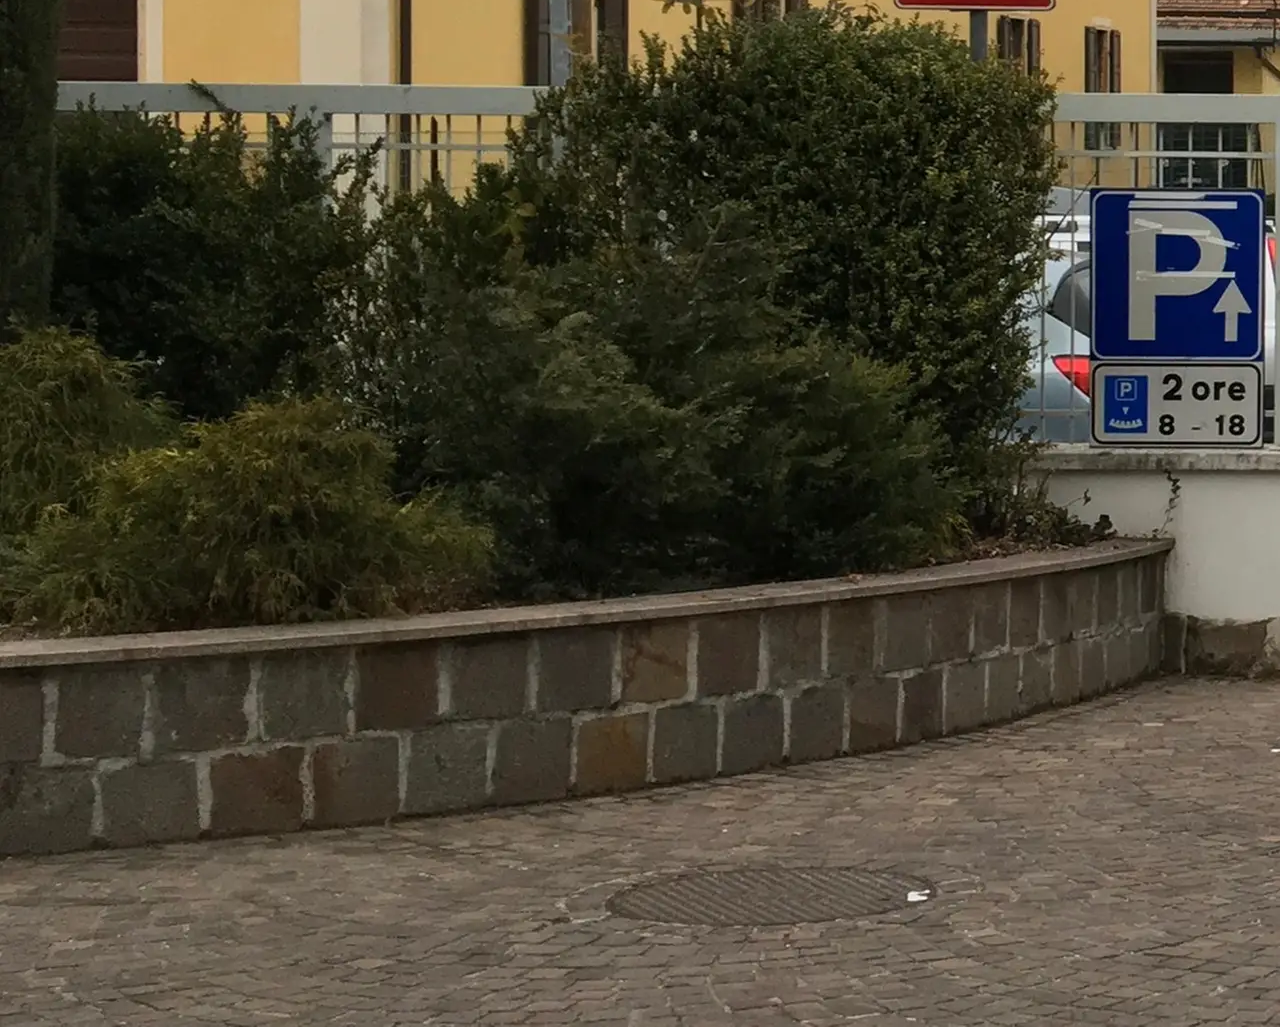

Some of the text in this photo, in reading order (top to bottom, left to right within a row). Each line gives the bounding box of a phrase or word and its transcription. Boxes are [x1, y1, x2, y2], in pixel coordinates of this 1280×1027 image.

[1162, 374, 1182, 401] 2
[1191, 379, 1246, 401] ore
[1159, 414, 1175, 436] 8
[1215, 414, 1245, 436] 18
